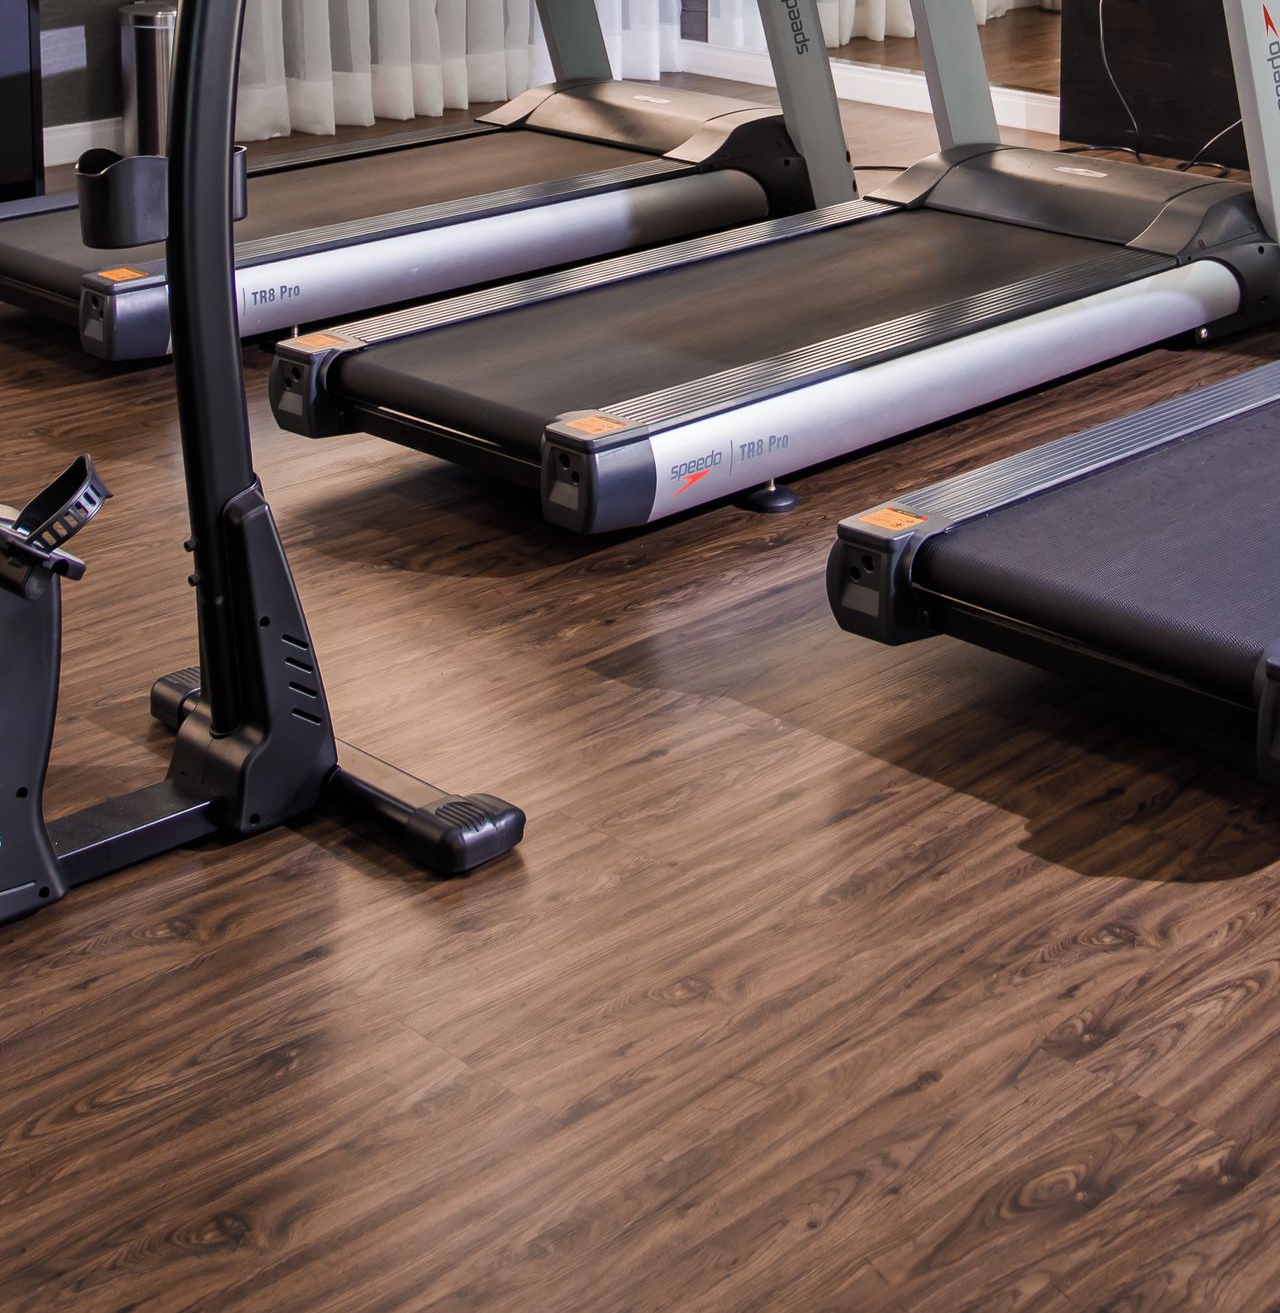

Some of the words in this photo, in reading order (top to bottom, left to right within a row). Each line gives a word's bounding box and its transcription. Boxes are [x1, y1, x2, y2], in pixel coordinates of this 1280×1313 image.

[252, 290, 275, 306] TR8
[280, 285, 300, 300] Pro
[671, 449, 722, 483] speedo
[739, 440, 763, 462] TR8
[768, 434, 789, 452] Pro
